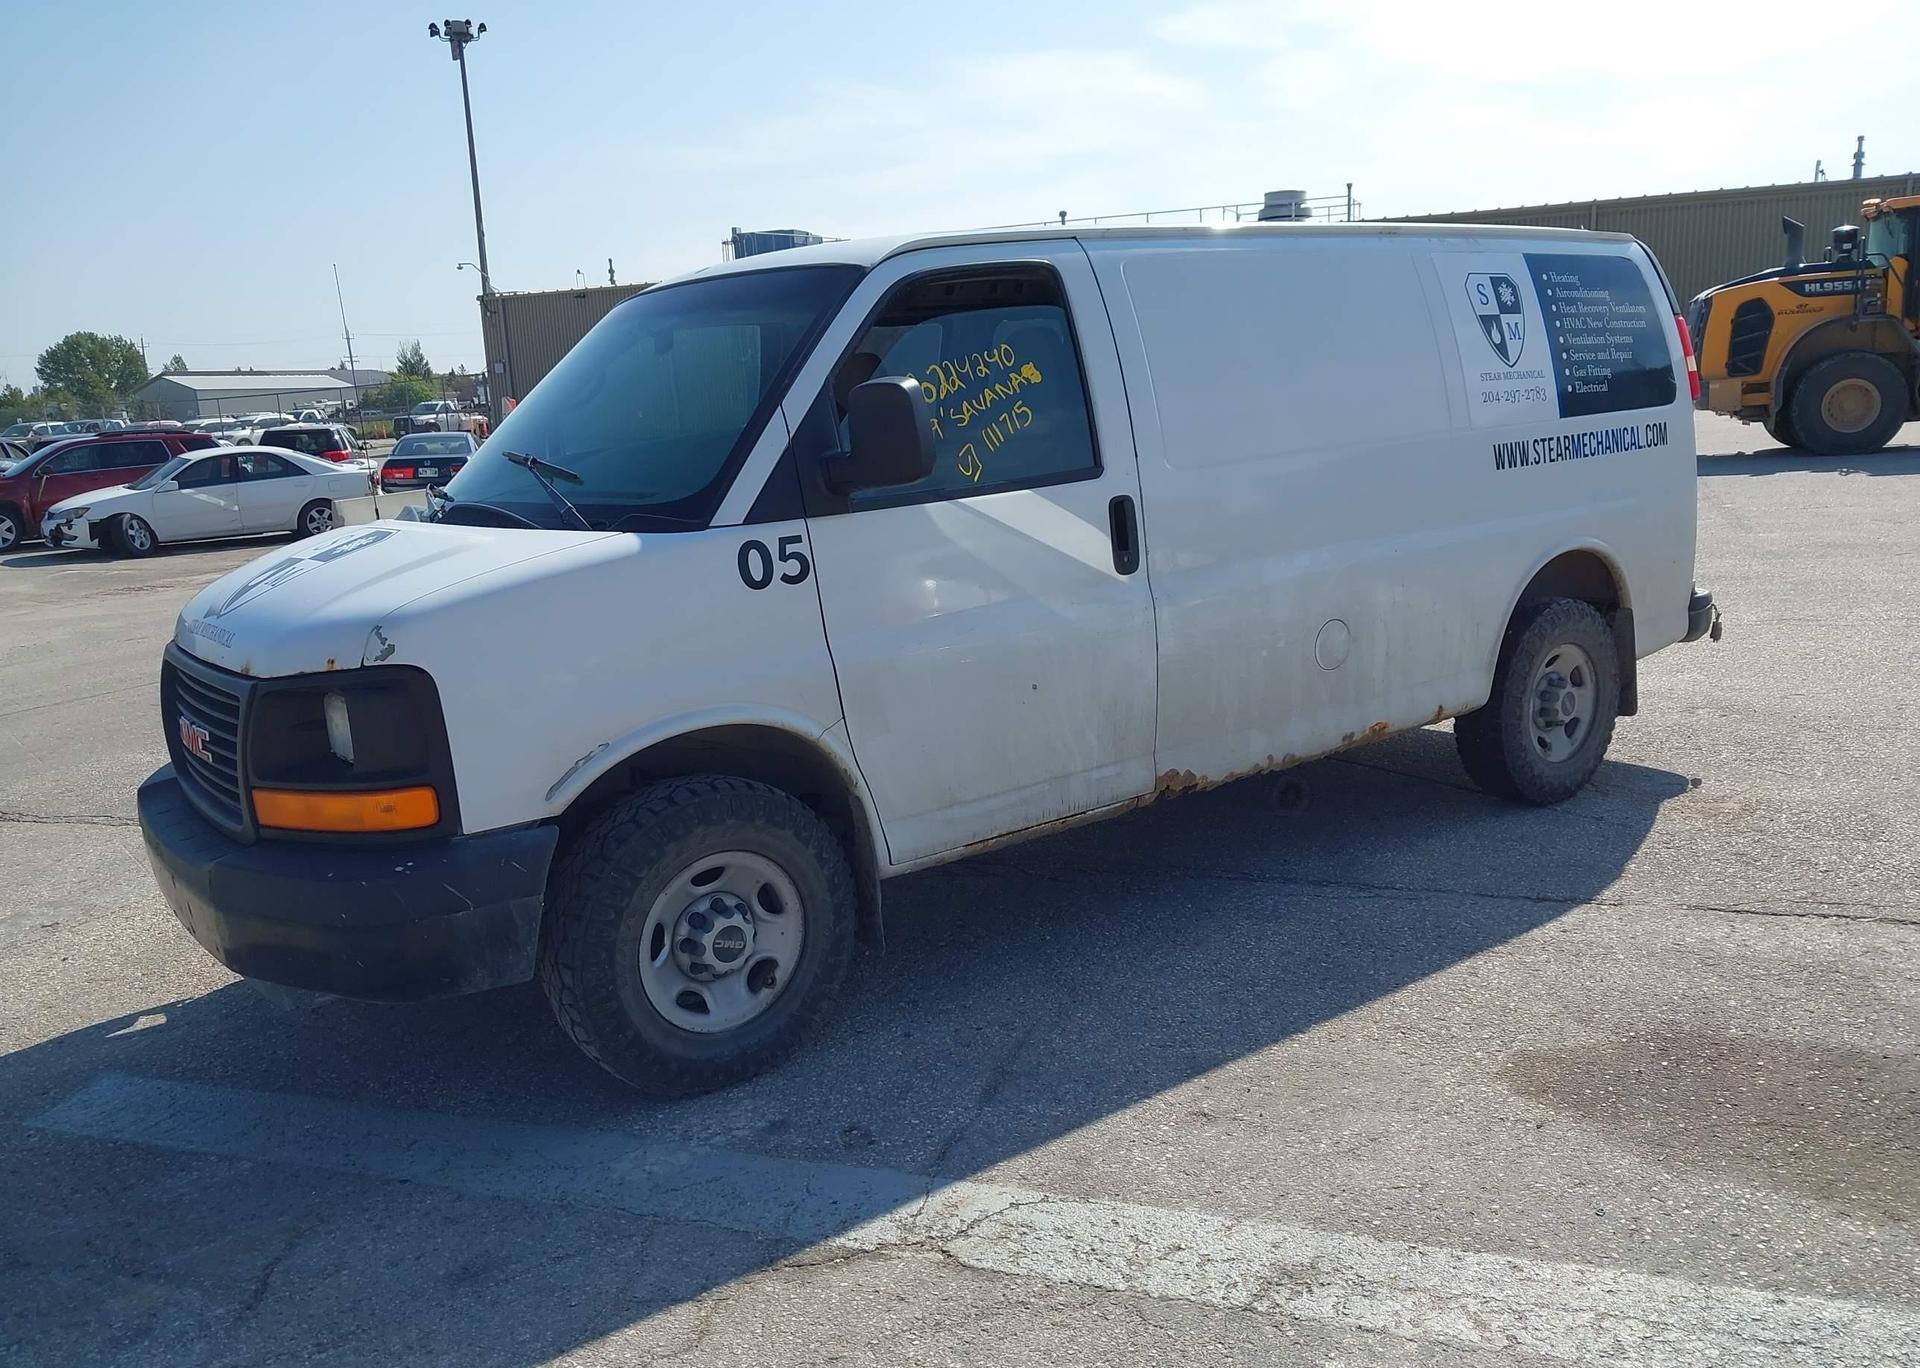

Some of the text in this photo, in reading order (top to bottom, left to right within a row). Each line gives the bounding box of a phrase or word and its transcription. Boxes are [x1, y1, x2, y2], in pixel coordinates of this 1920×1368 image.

[1551, 272, 1580, 286] Heating
[1476, 283, 1490, 306] S
[1555, 287, 1611, 301] Airconditioning
[1559, 302, 1646, 317] Heat Recovery Ventilators
[1564, 317, 1647, 330] HVAC New Construction
[1507, 322, 1523, 341] M
[1566, 333, 1634, 347] Ventilation Systems
[1570, 348, 1633, 363] Service and Repair
[1480, 369, 1546, 382] STEAR MECHANICAL
[1573, 364, 1612, 379] Gas Fitting
[1481, 386, 1547, 404] 204-297-2783
[1574, 382, 1609, 394] Electrical
[1493, 421, 1669, 471] WWW.STEARMECHANICAL.COM
[737, 533, 811, 590] 05
[714, 939, 745, 949] GMC
